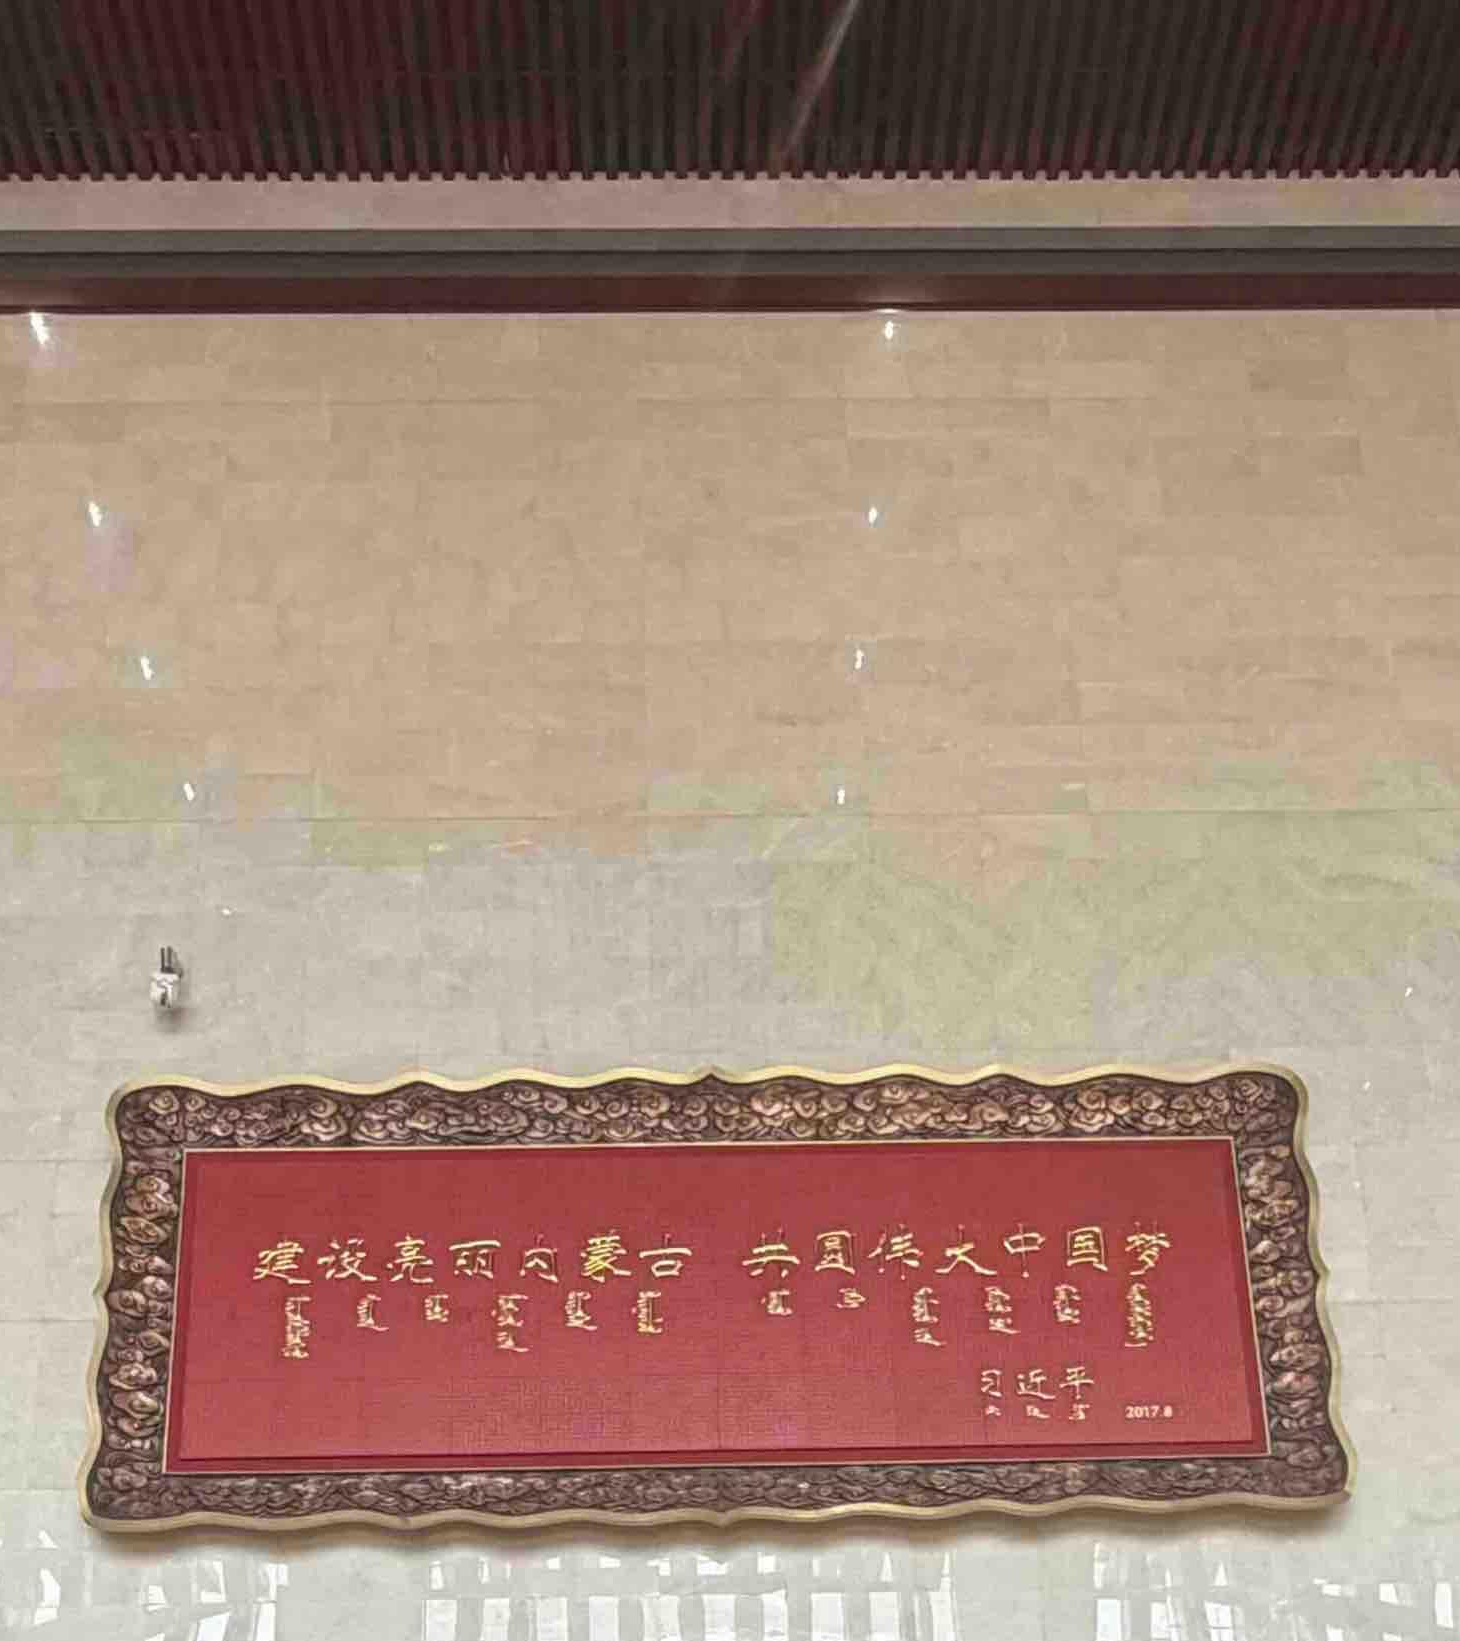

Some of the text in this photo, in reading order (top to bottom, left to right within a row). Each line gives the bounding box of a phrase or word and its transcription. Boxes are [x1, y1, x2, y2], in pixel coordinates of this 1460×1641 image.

[252, 1222, 1173, 1285] 建设亮丽内蒙古 共圆伟大中国梦
[979, 1366, 1095, 1401] 习近平
[1125, 1404, 1173, 1419] 2017.8
